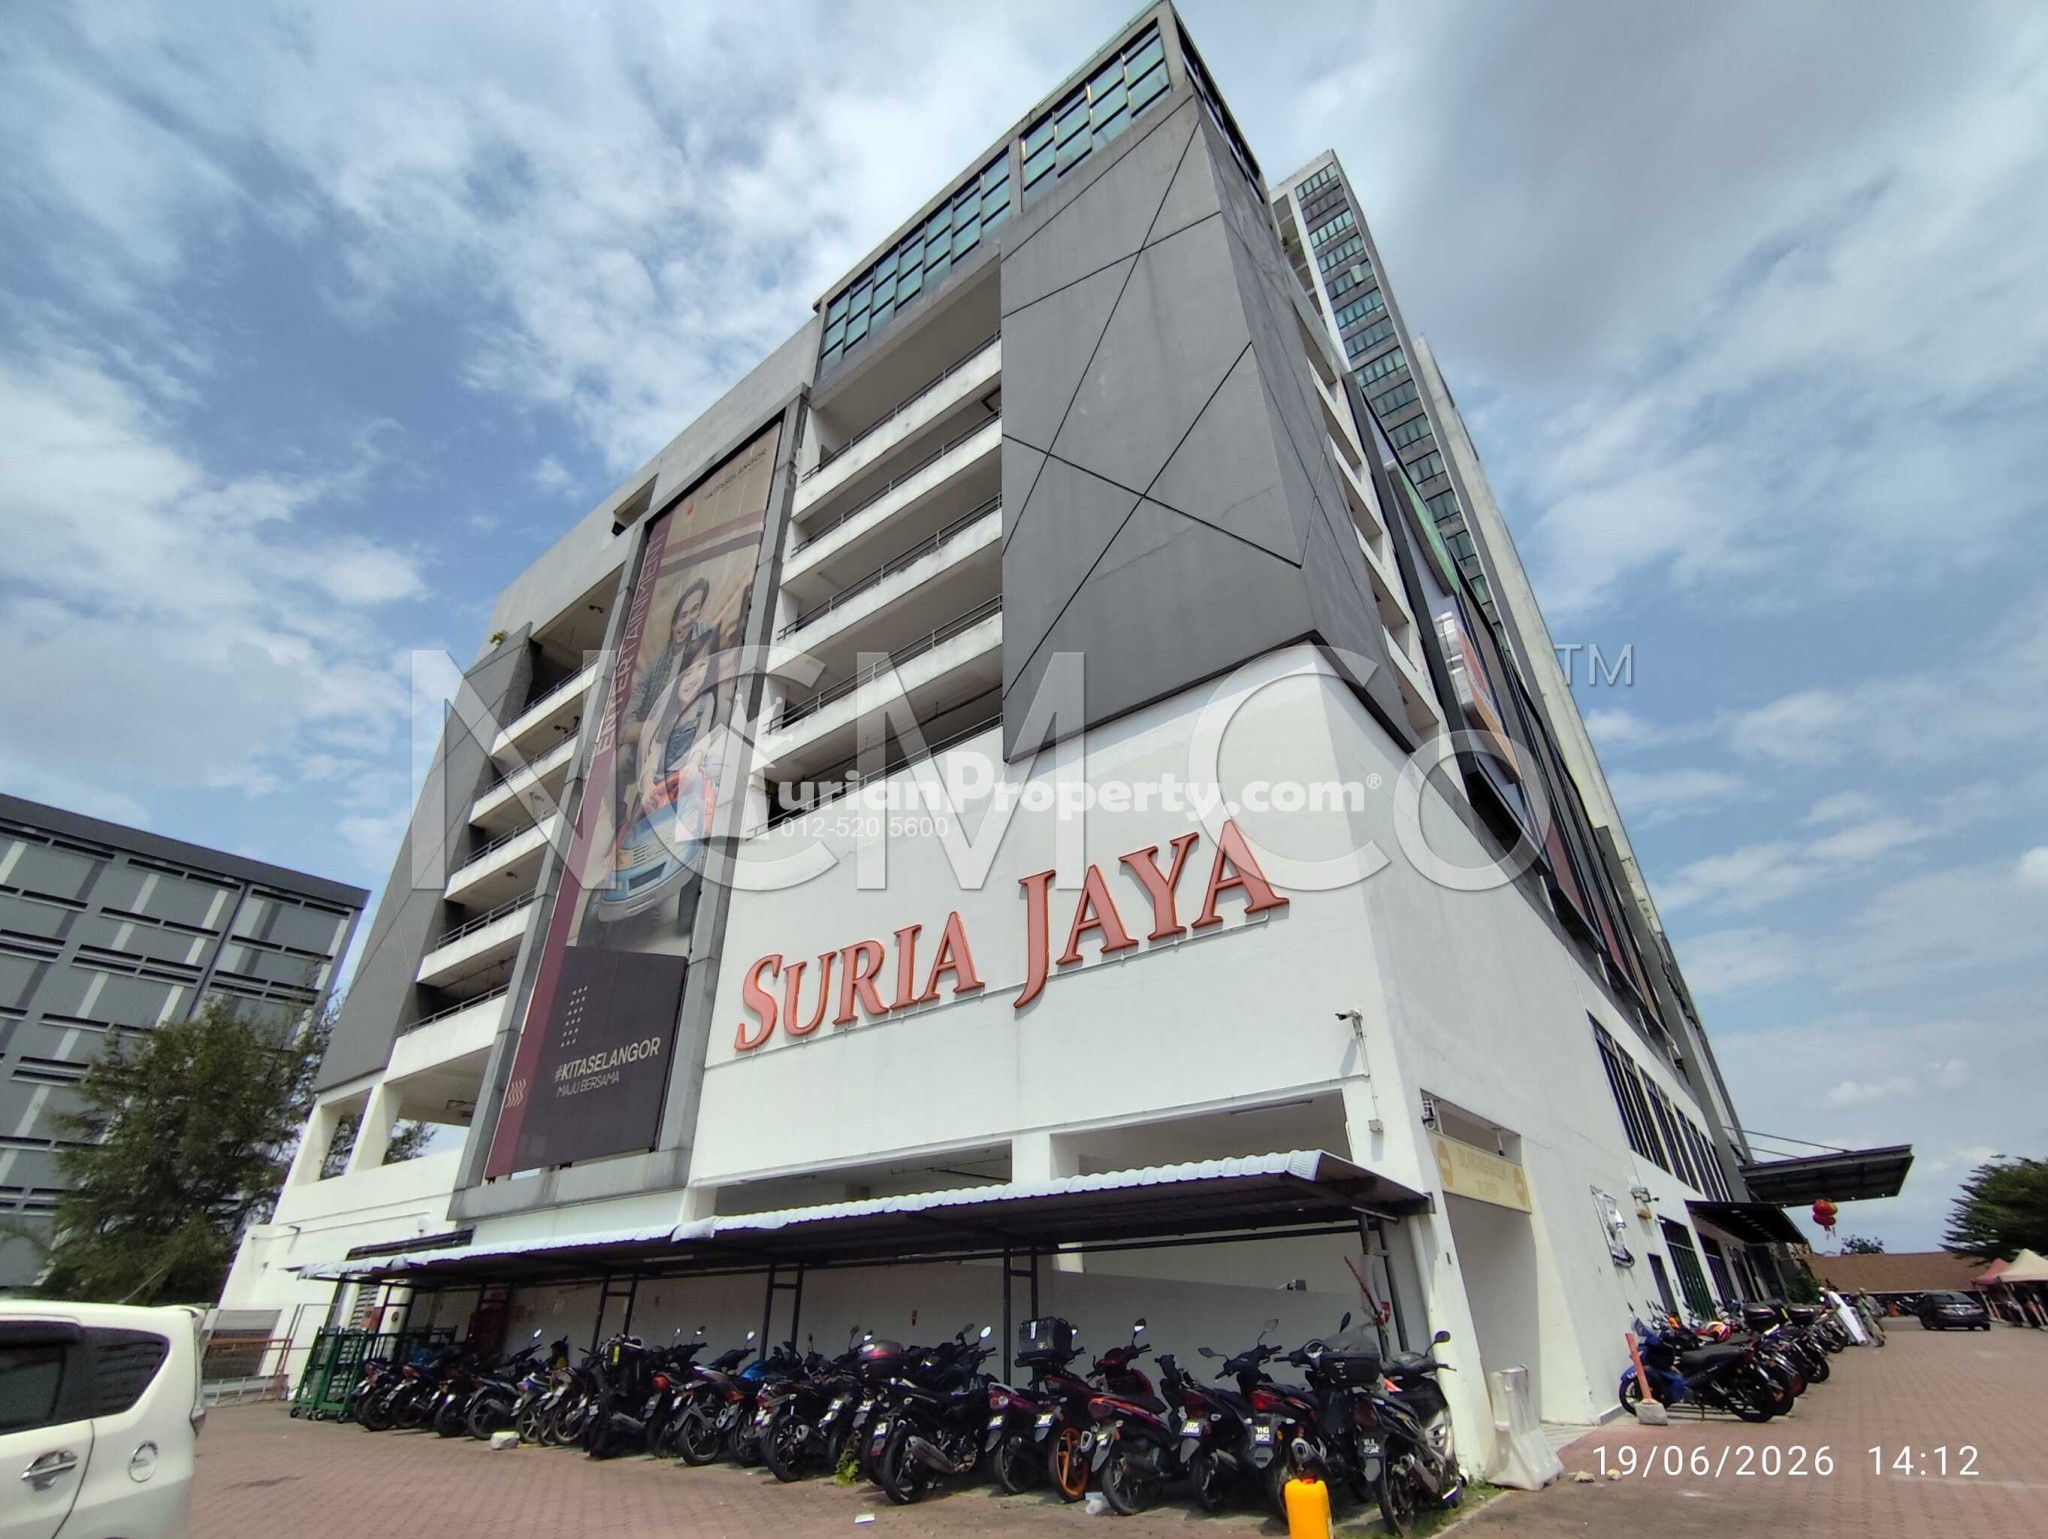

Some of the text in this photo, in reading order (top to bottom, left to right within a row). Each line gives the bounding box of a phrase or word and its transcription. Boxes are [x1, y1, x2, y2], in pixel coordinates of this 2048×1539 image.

[599, 533, 665, 752] ENTERTAINMENT
[733, 818, 1291, 1052] SURIA JAYA
[554, 1036, 662, 1082] #KITASELANGOR
[556, 1070, 620, 1099] MAJU BERSAMA
